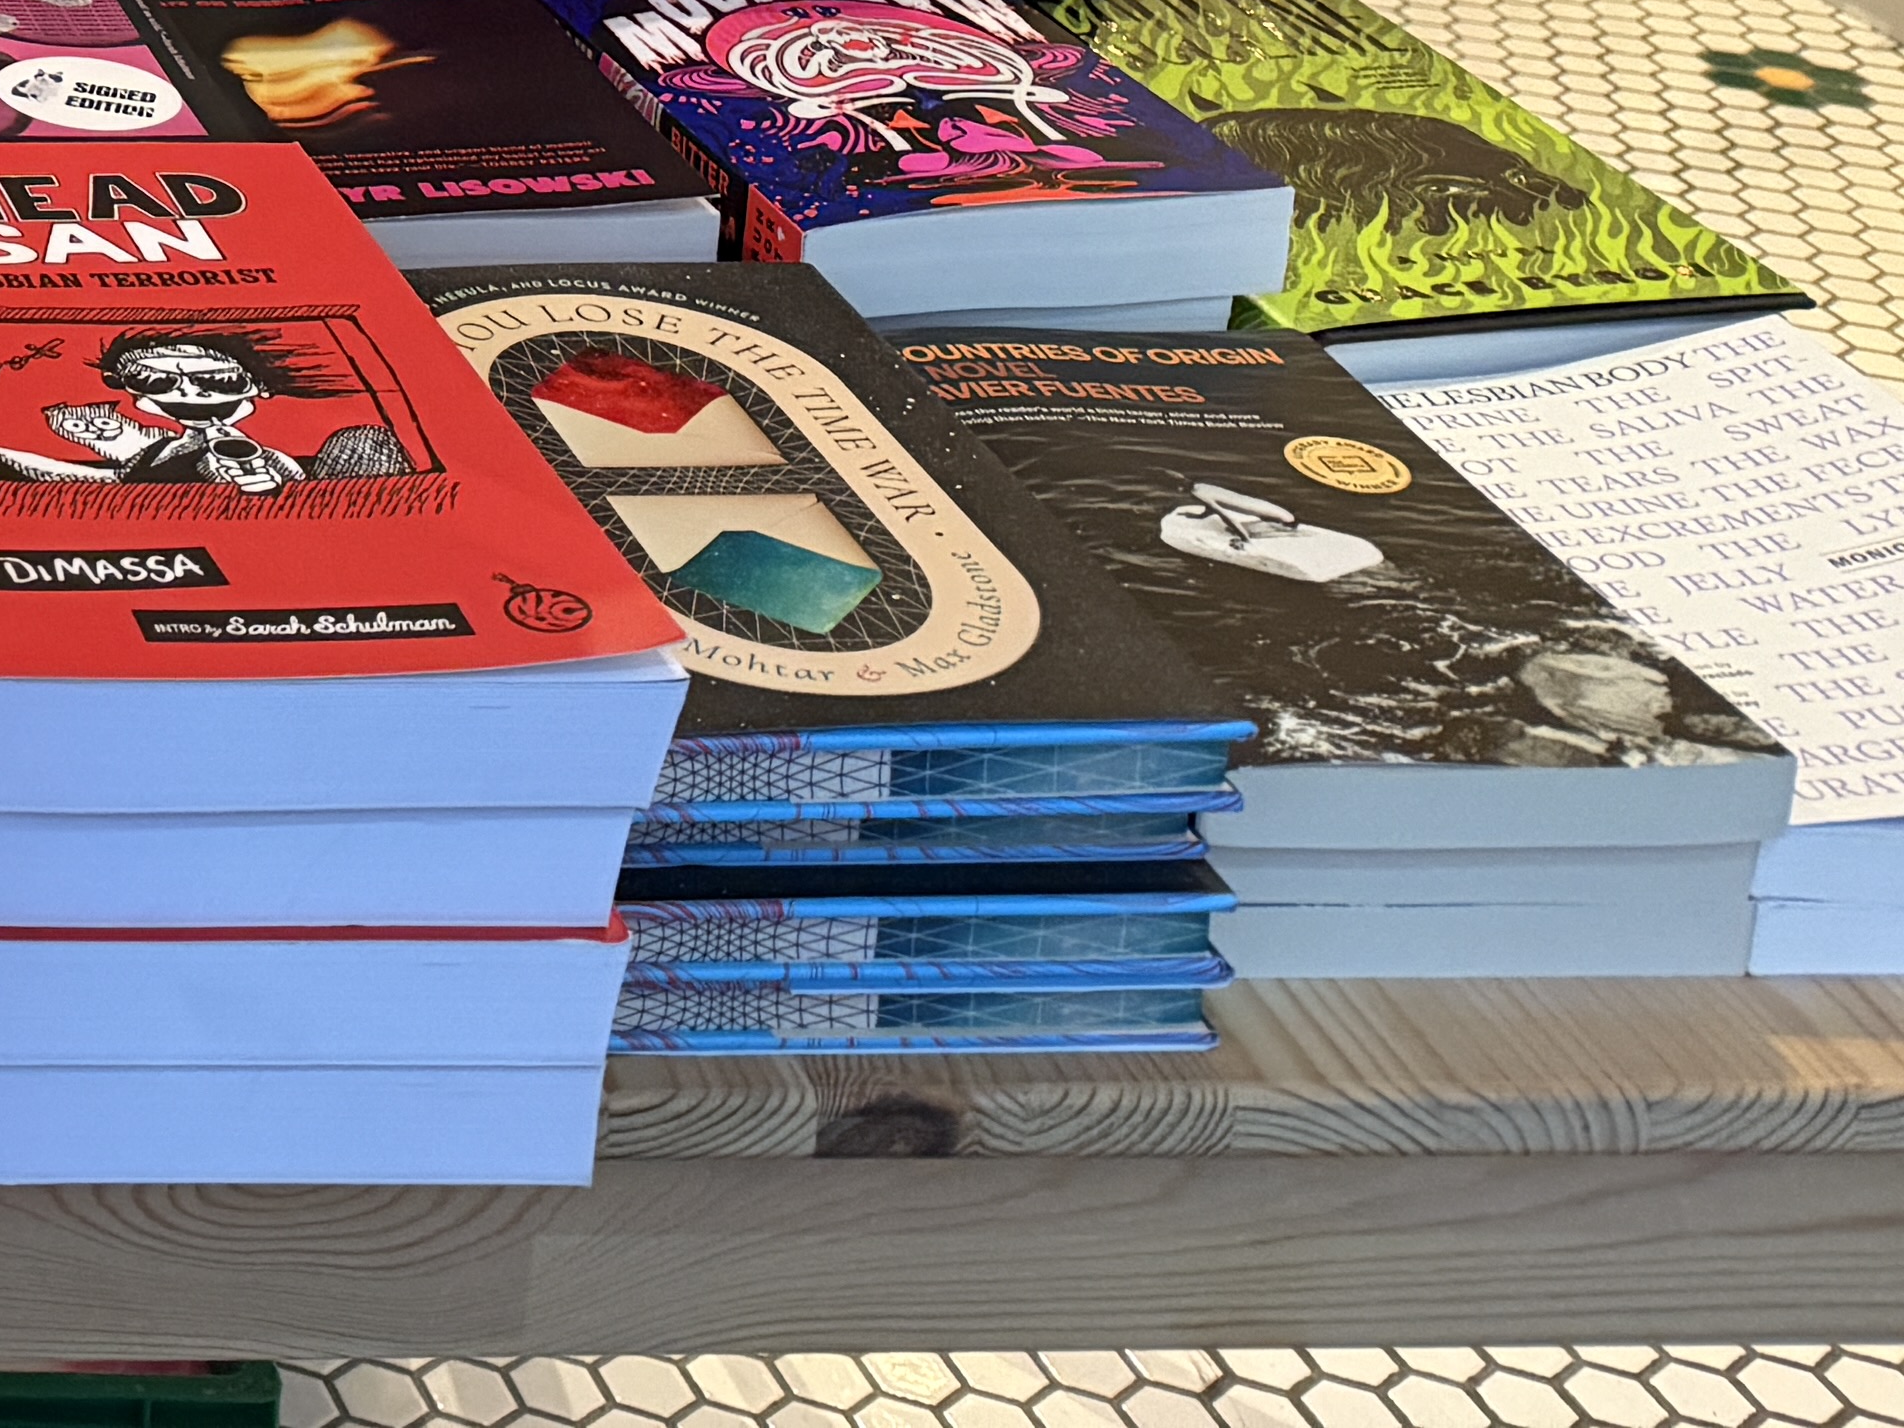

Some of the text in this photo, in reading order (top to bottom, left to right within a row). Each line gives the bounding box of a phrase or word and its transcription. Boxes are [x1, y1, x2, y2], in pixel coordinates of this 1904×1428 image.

[418, 169, 655, 198] LISOWSKI
[1092, 346, 1284, 365] OF ORIGIN
[1539, 466, 1682, 497] TEARS
